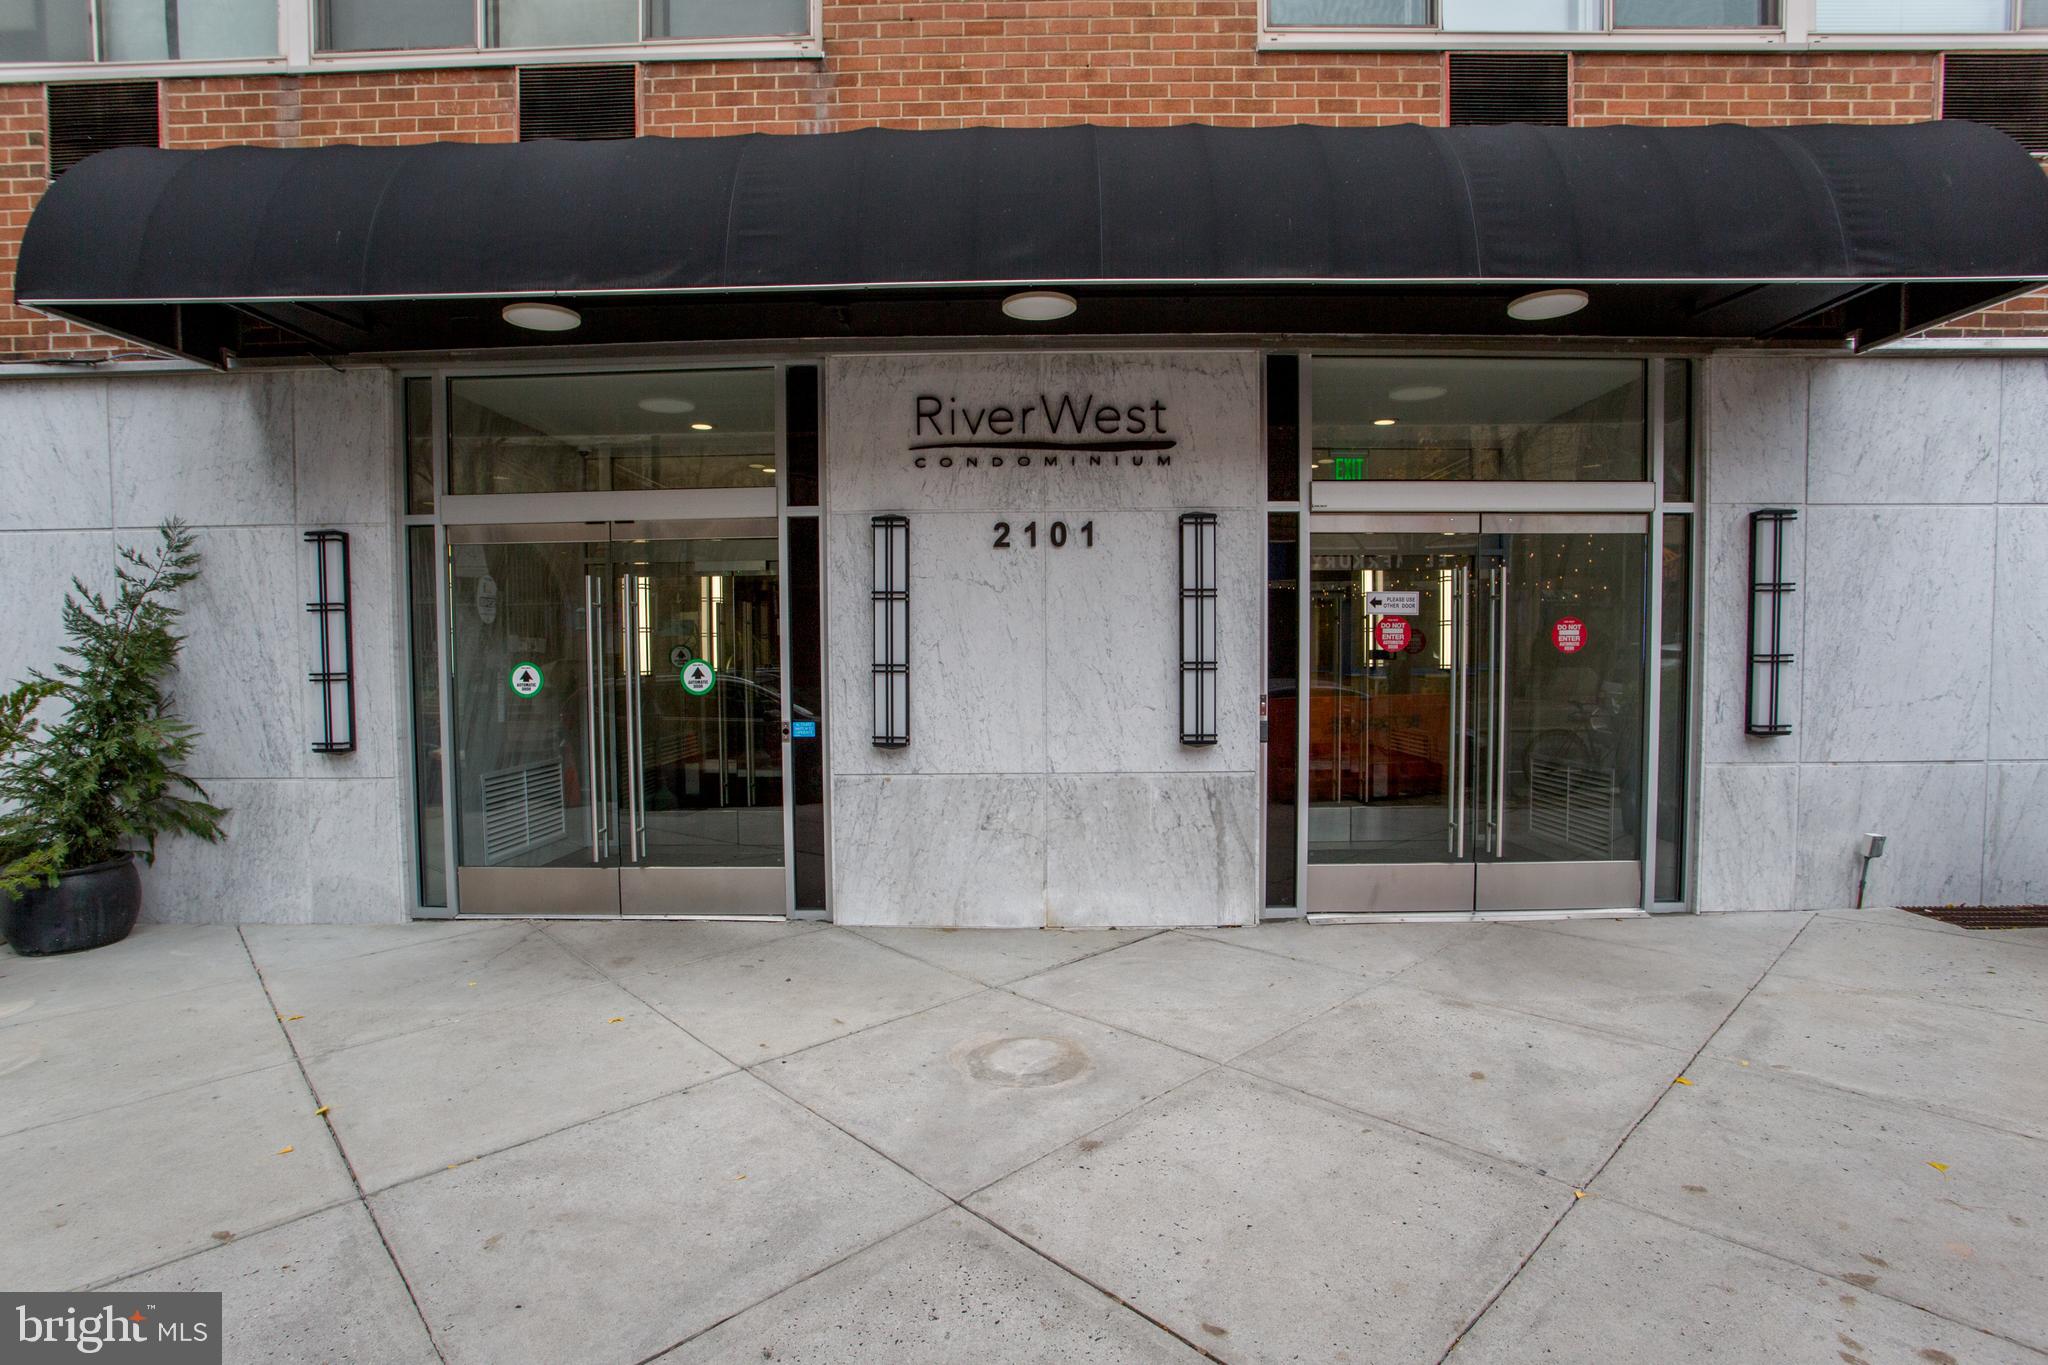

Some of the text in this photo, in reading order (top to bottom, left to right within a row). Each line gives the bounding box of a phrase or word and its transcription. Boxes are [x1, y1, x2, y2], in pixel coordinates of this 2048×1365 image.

[916, 394, 1168, 436] RiverWest
[914, 455, 1172, 468] CONDOMINIUM
[1335, 457, 1364, 480] EXIT
[993, 521, 1093, 548] 2101
